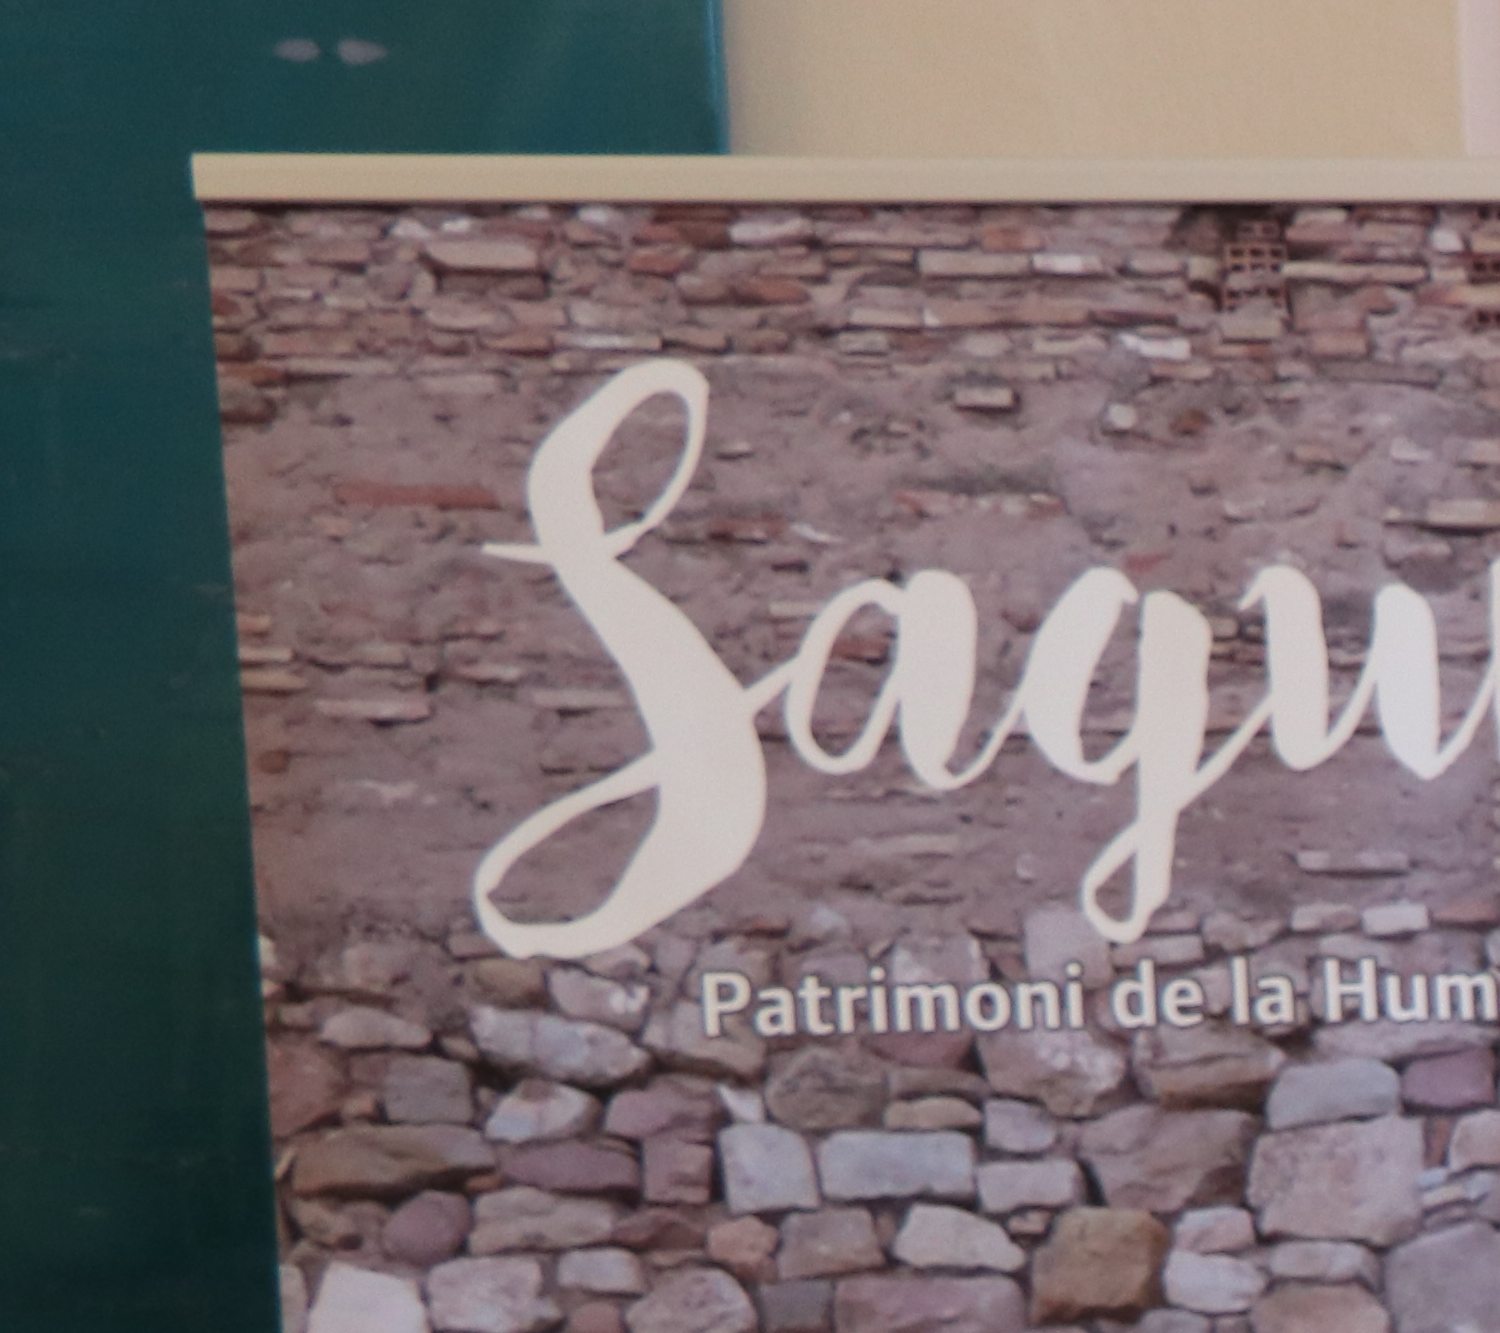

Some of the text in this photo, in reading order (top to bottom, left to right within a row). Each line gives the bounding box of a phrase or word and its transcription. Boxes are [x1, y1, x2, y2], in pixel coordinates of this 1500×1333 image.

[701, 966, 1086, 1038] Patrimoni
[1112, 965, 1204, 1029] de
[1232, 962, 1298, 1027] la
